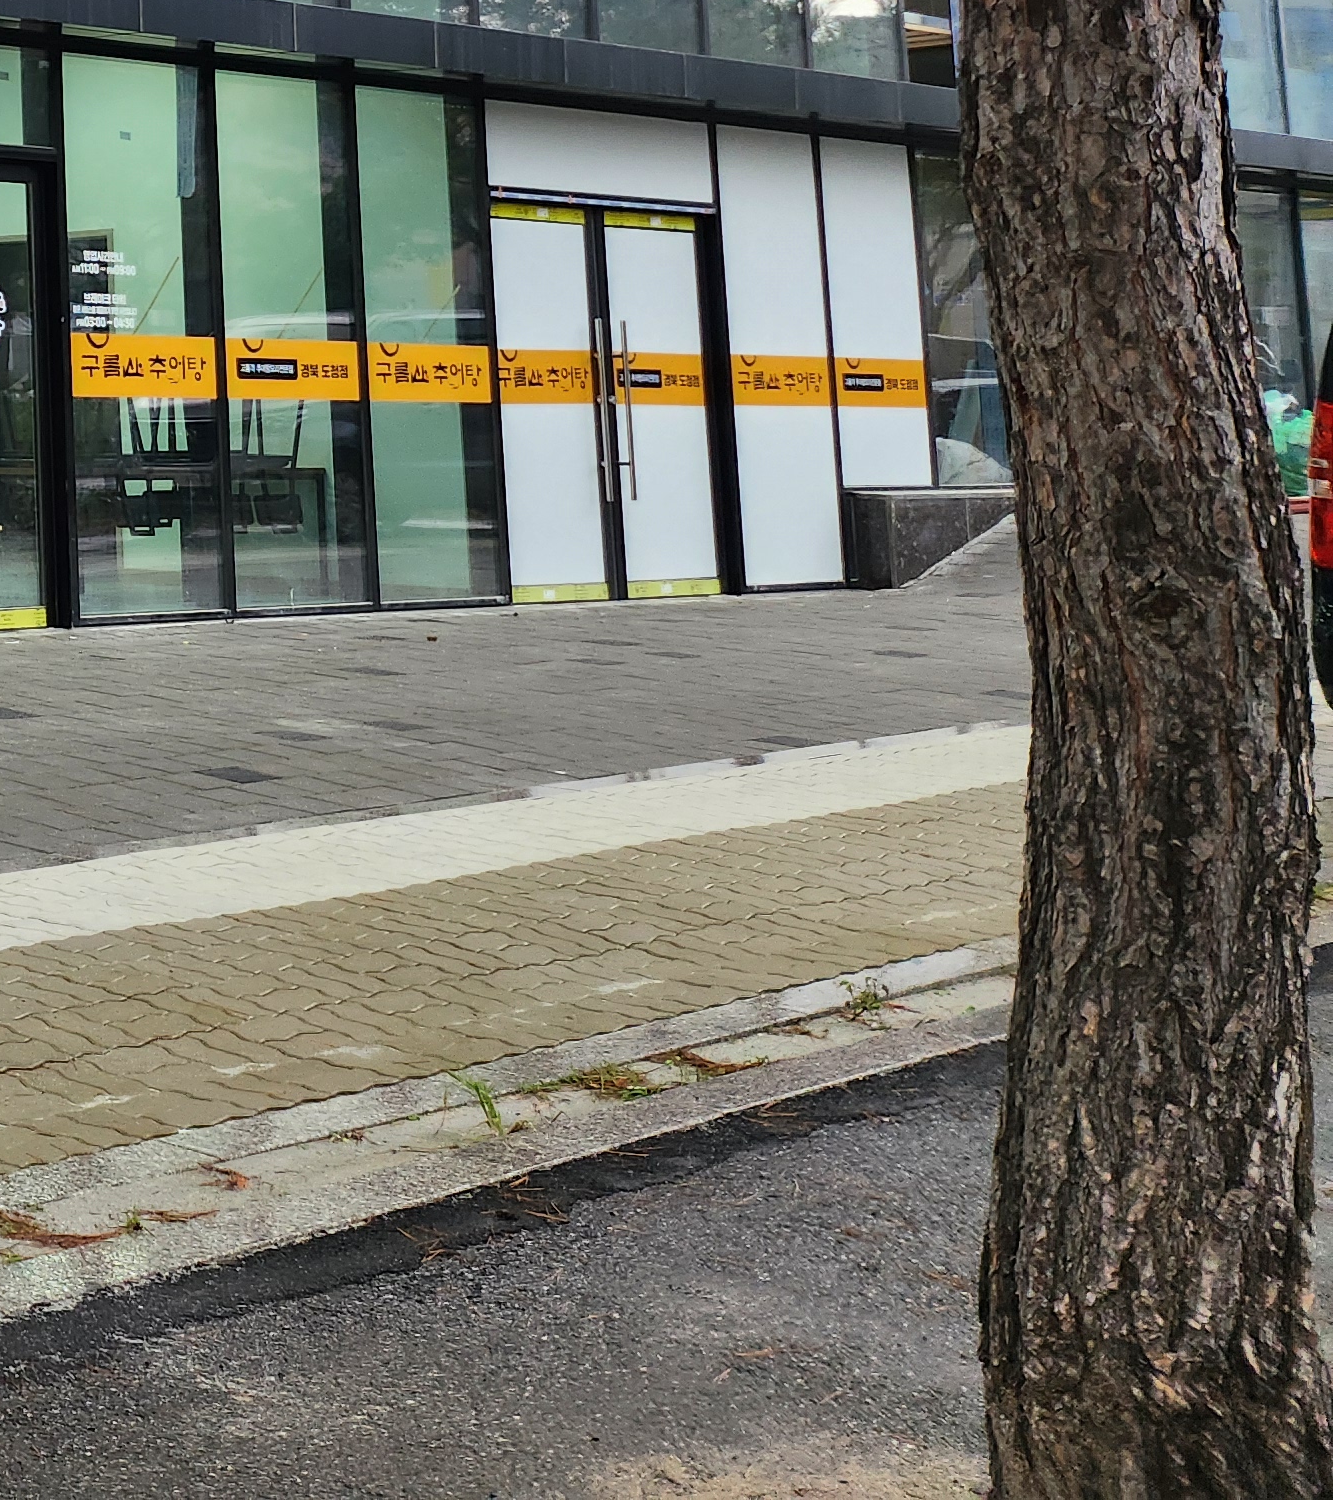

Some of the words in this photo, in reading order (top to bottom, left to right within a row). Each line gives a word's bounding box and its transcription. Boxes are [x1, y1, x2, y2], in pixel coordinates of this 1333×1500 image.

[81, 354, 144, 379] 구름산
[148, 354, 207, 382] 추어탕
[376, 361, 429, 384] 구름산
[433, 361, 481, 387] 추어탕
[497, 366, 544, 388] 구름산
[546, 365, 589, 389] 추어탕
[738, 370, 781, 391] 구름산
[783, 370, 822, 392] 추어탕
